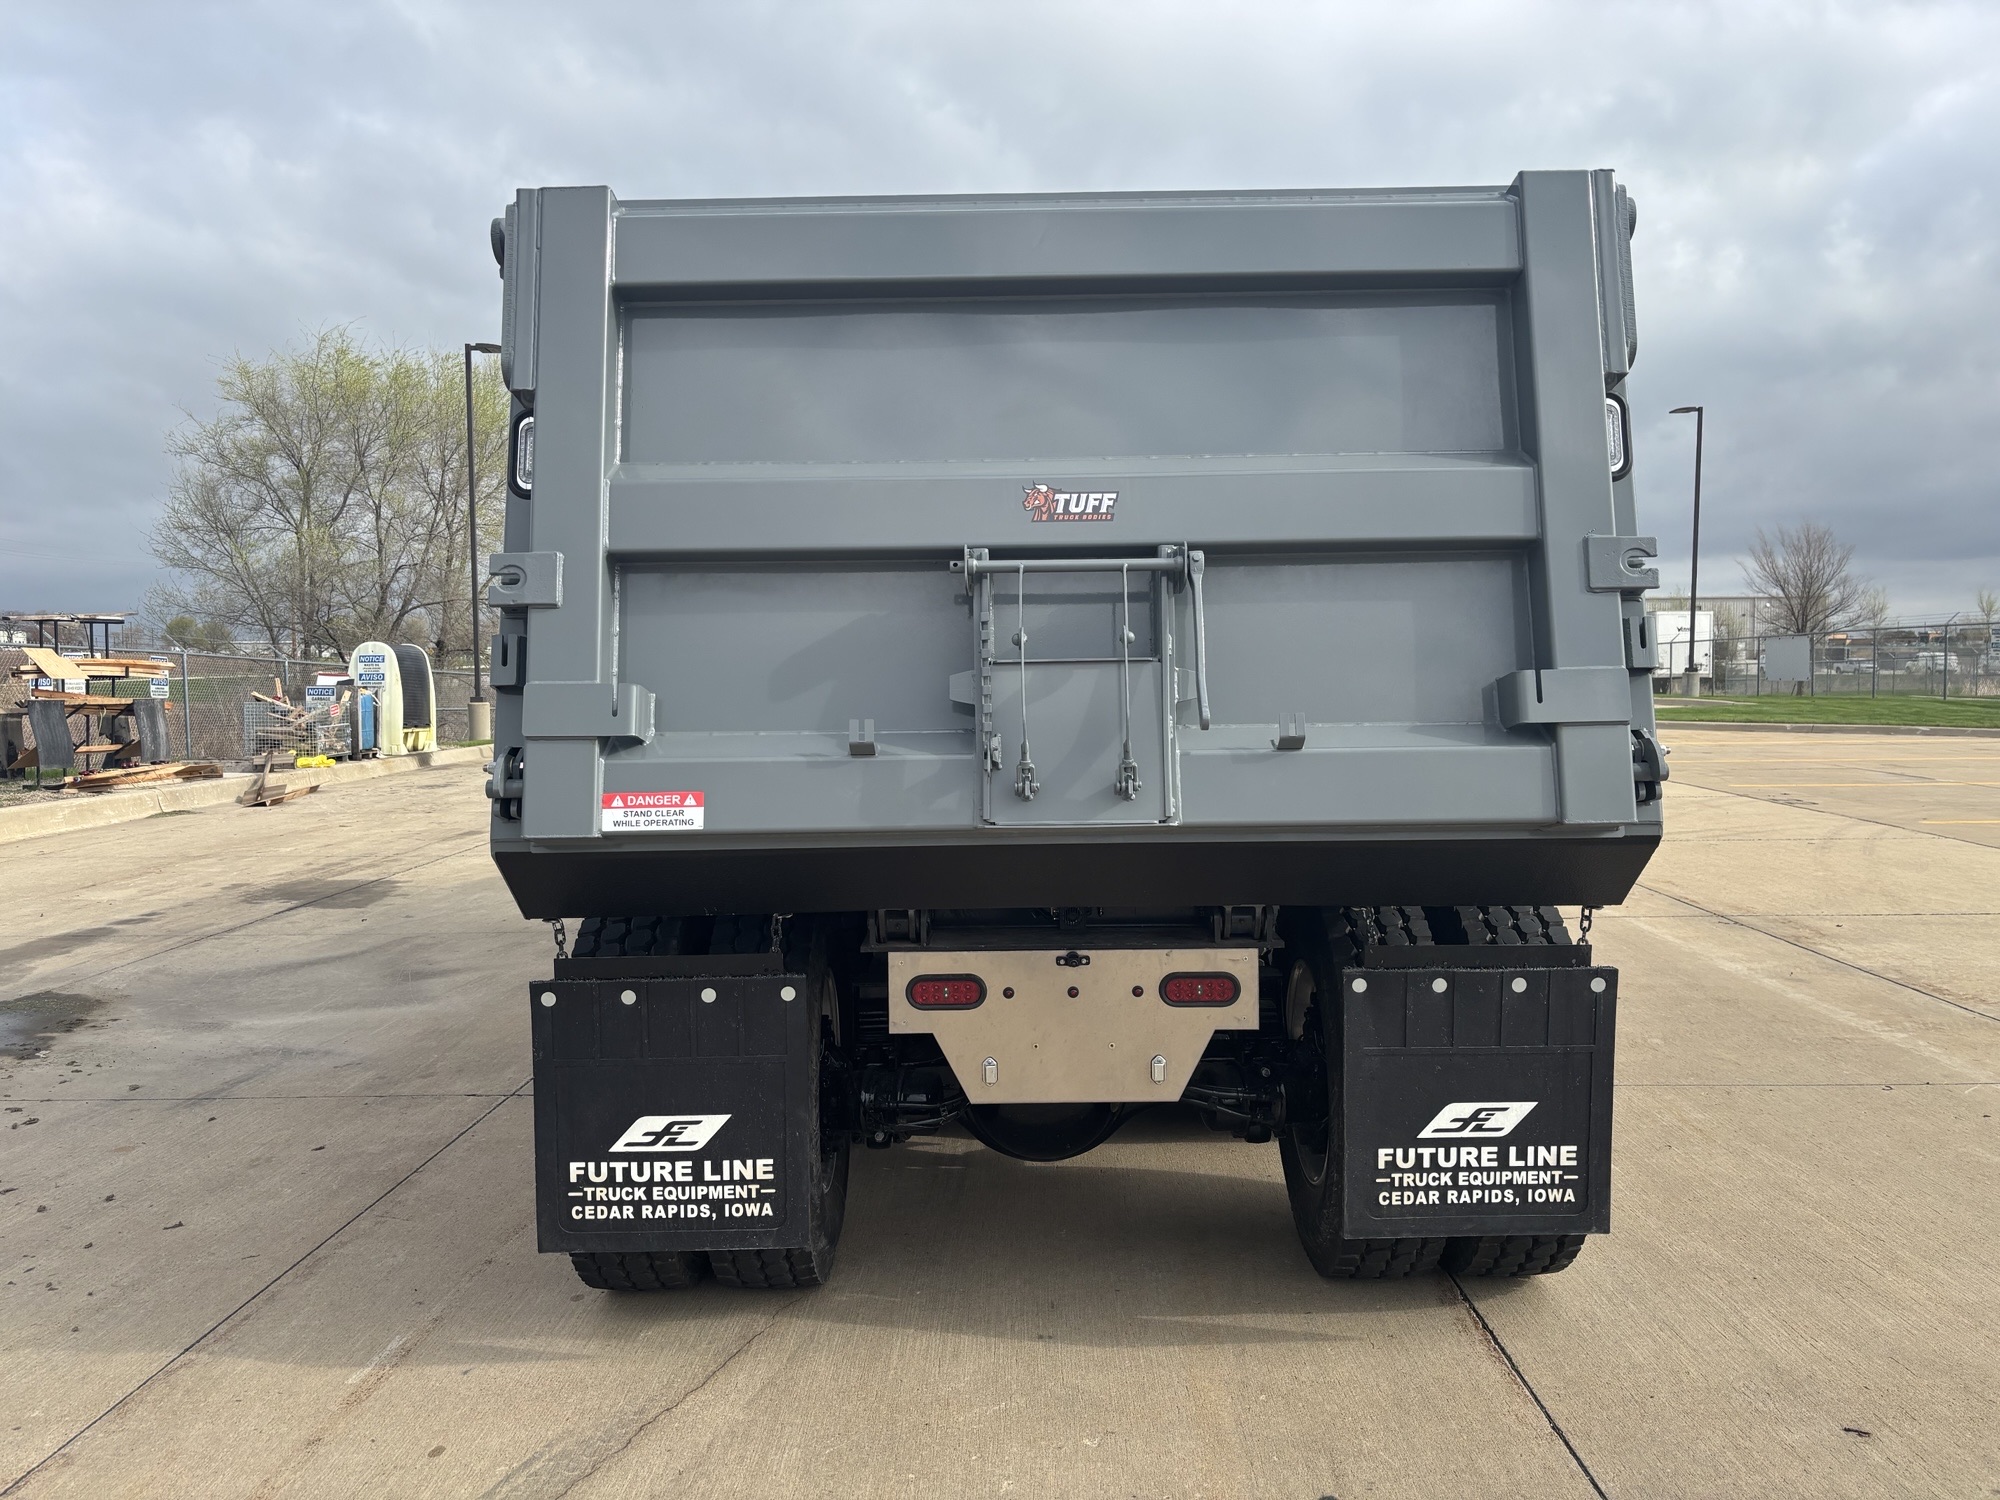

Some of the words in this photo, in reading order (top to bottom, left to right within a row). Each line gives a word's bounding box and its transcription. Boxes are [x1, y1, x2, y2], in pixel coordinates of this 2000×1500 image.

[1054, 493, 1117, 513] TUFF
[627, 795, 681, 806] DANGER
[623, 810, 652, 818] STAND
[655, 809, 685, 817] CLEAR
[643, 818, 694, 827] OPERATING
[1377, 1146, 1499, 1170] FUTURE
[1508, 1145, 1578, 1168] LINE
[569, 1160, 694, 1183] FUTURE
[703, 1158, 775, 1182] LINE
[1390, 1172, 1453, 1188] TRUCK
[1458, 1170, 1564, 1187] EQUIPMENT
[583, 1186, 648, 1202] TRUCK
[652, 1184, 760, 1201] EQUIPMENT
[1378, 1190, 1440, 1206] CEDAR
[1446, 1188, 1520, 1206] RAPIDS,
[1527, 1188, 1576, 1203] IOWA
[571, 1205, 635, 1220] CEDAR
[641, 1203, 718, 1221] RAPIDS,
[724, 1202, 774, 1218] IOWA
